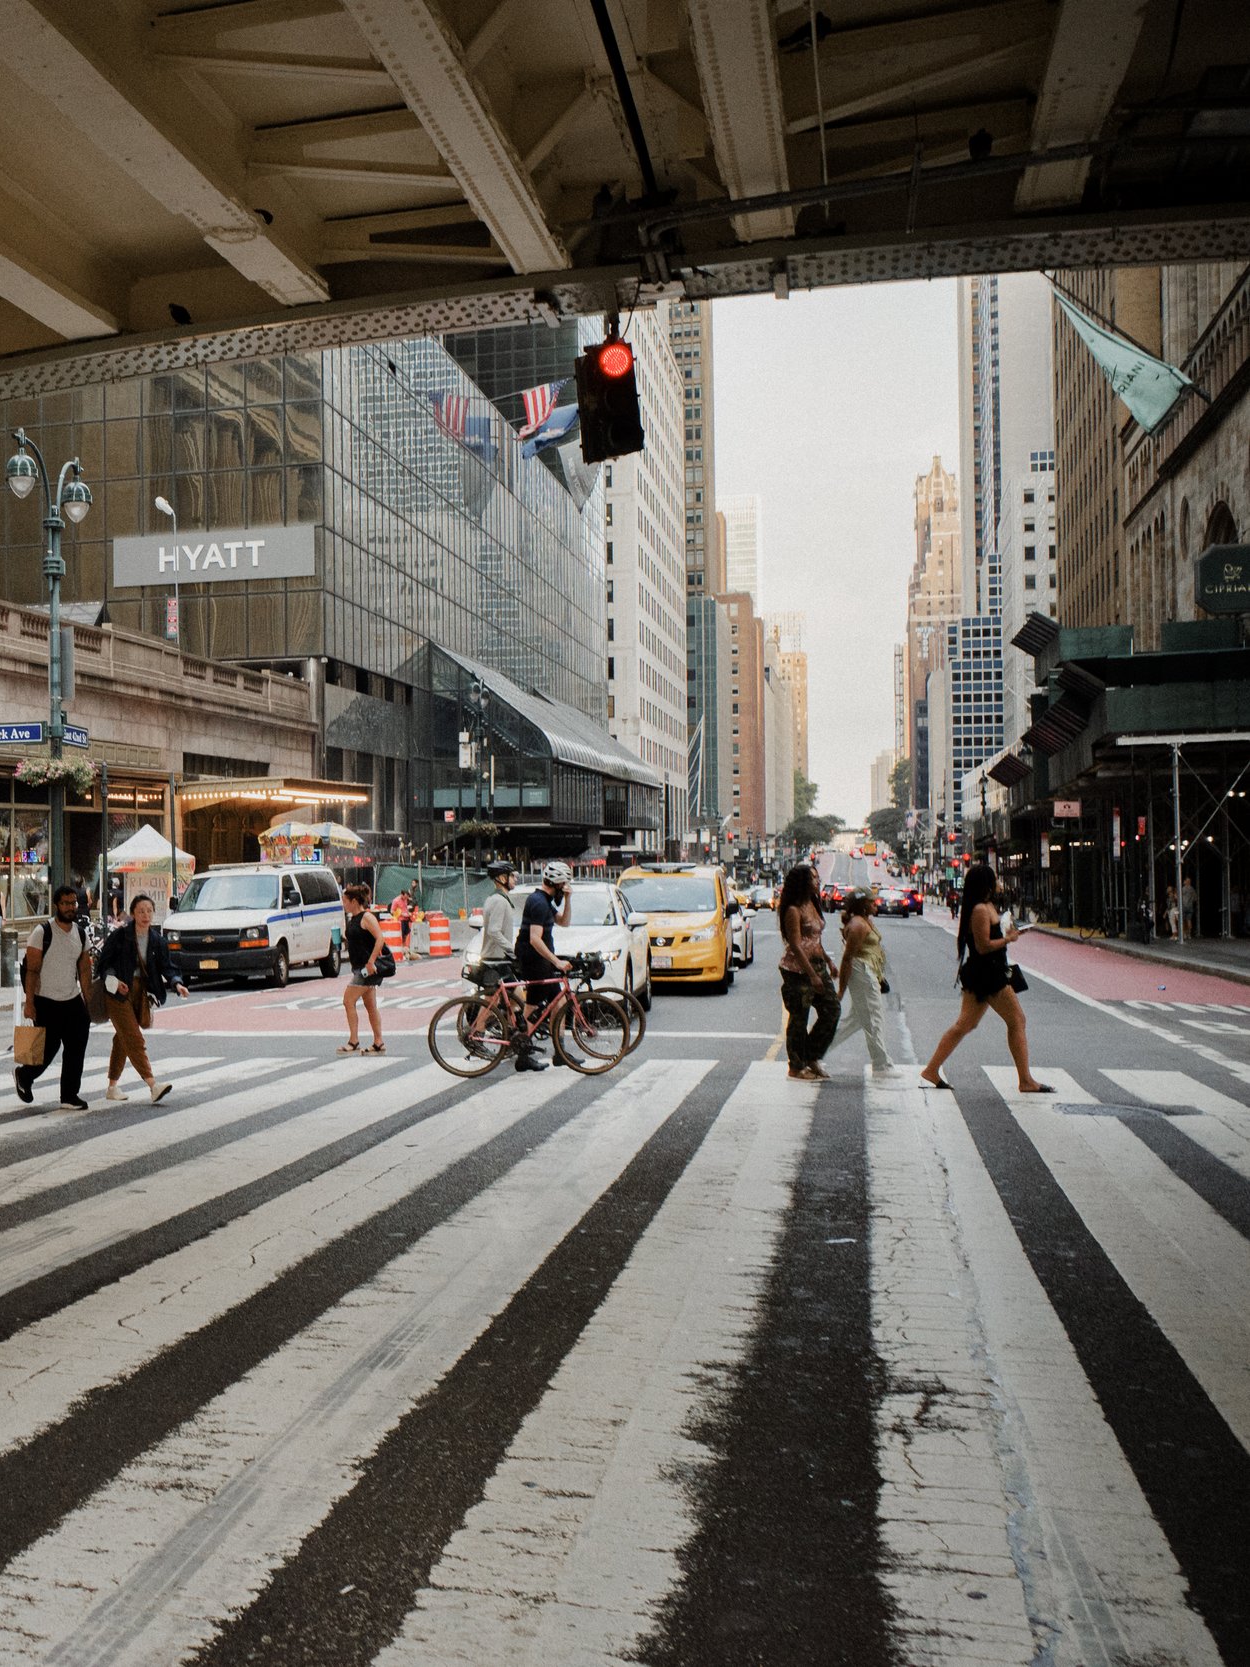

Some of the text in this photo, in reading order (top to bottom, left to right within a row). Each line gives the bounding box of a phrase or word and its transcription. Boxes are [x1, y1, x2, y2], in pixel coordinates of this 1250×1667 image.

[1117, 361, 1145, 393] RIANI
[159, 540, 266, 573] HYATT
[11, 728, 30, 739] Ave
